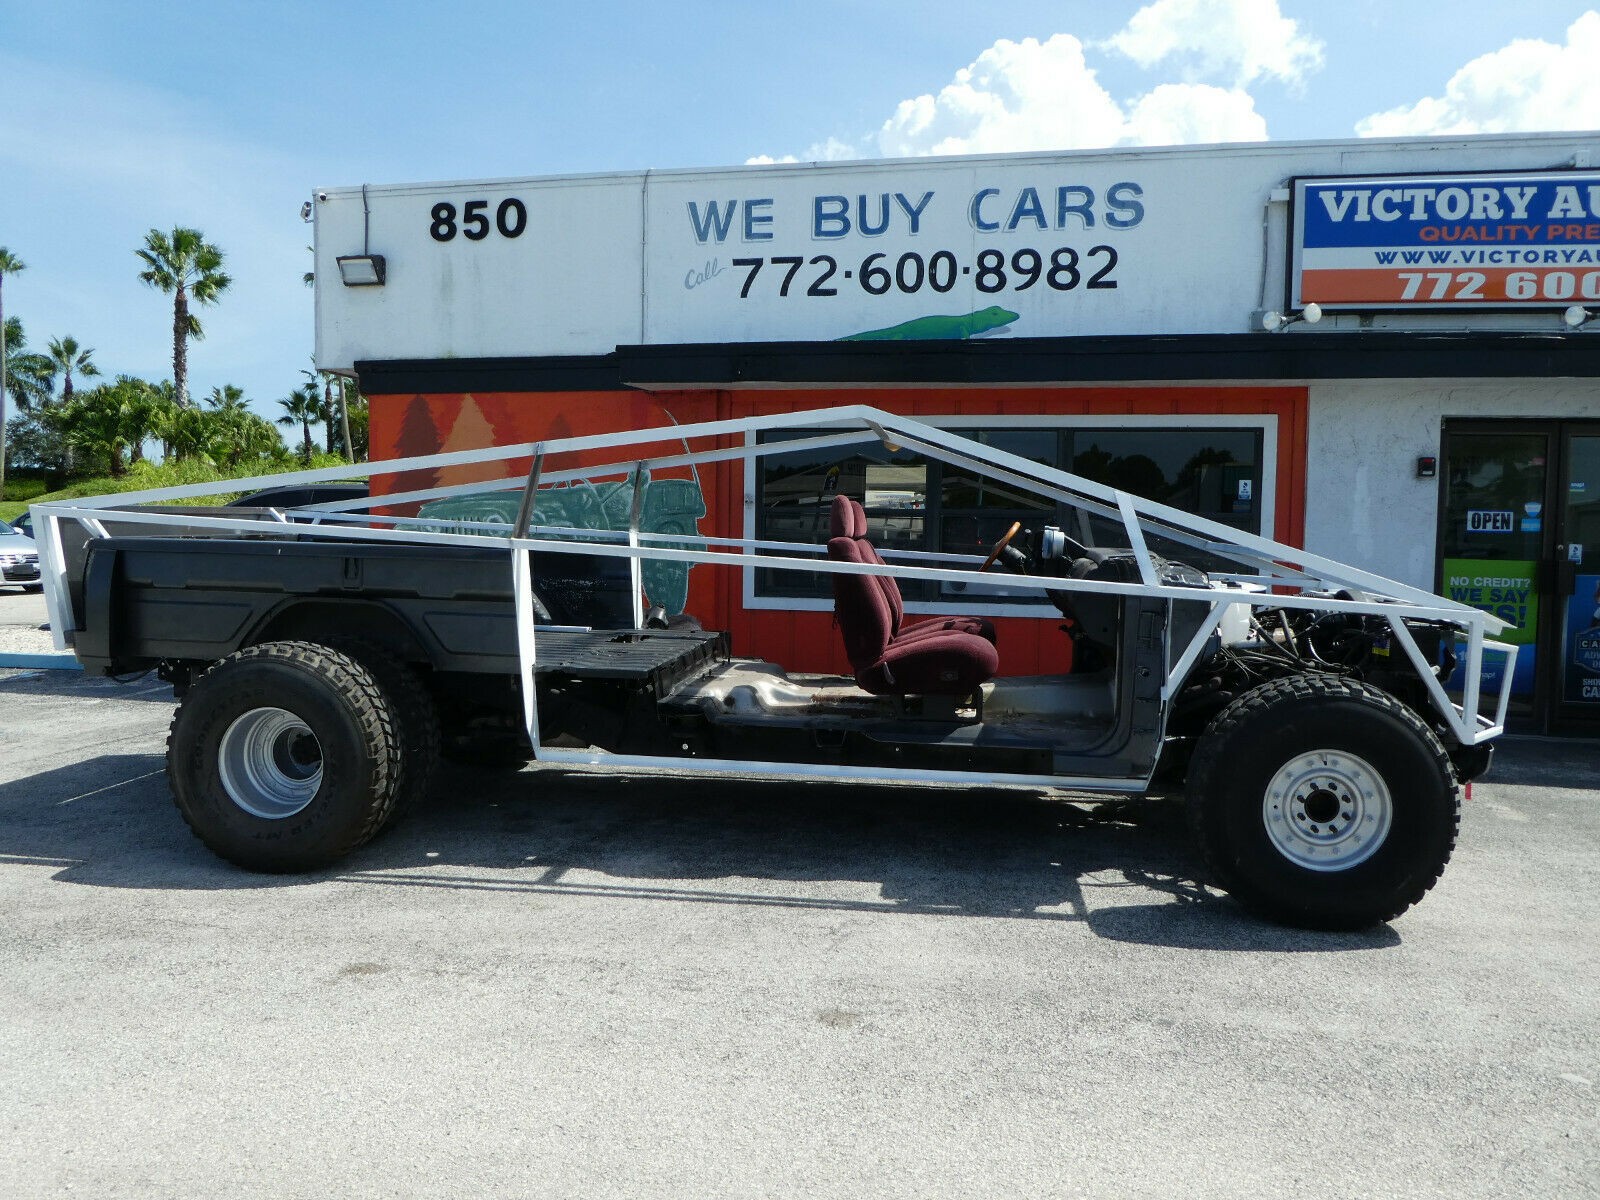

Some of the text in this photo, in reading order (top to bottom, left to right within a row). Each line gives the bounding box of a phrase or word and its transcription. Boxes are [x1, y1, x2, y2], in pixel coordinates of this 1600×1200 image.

[686, 181, 1145, 243] WE BUY CARS
[1318, 185, 1538, 222] VICTORY
[430, 197, 528, 242] 850
[1418, 224, 1541, 242] QUALITY
[1374, 249, 1600, 265] WWW.VICTORYA
[684, 257, 726, 291] Call
[1397, 272, 1486, 300] 772
[1471, 511, 1511, 530] OPEN
[1450, 576, 1531, 588] NO CREDIT?
[1450, 587, 1530, 603] WE SAY
[1474, 604, 1528, 628] S!
[1581, 640, 1600, 648] CA
